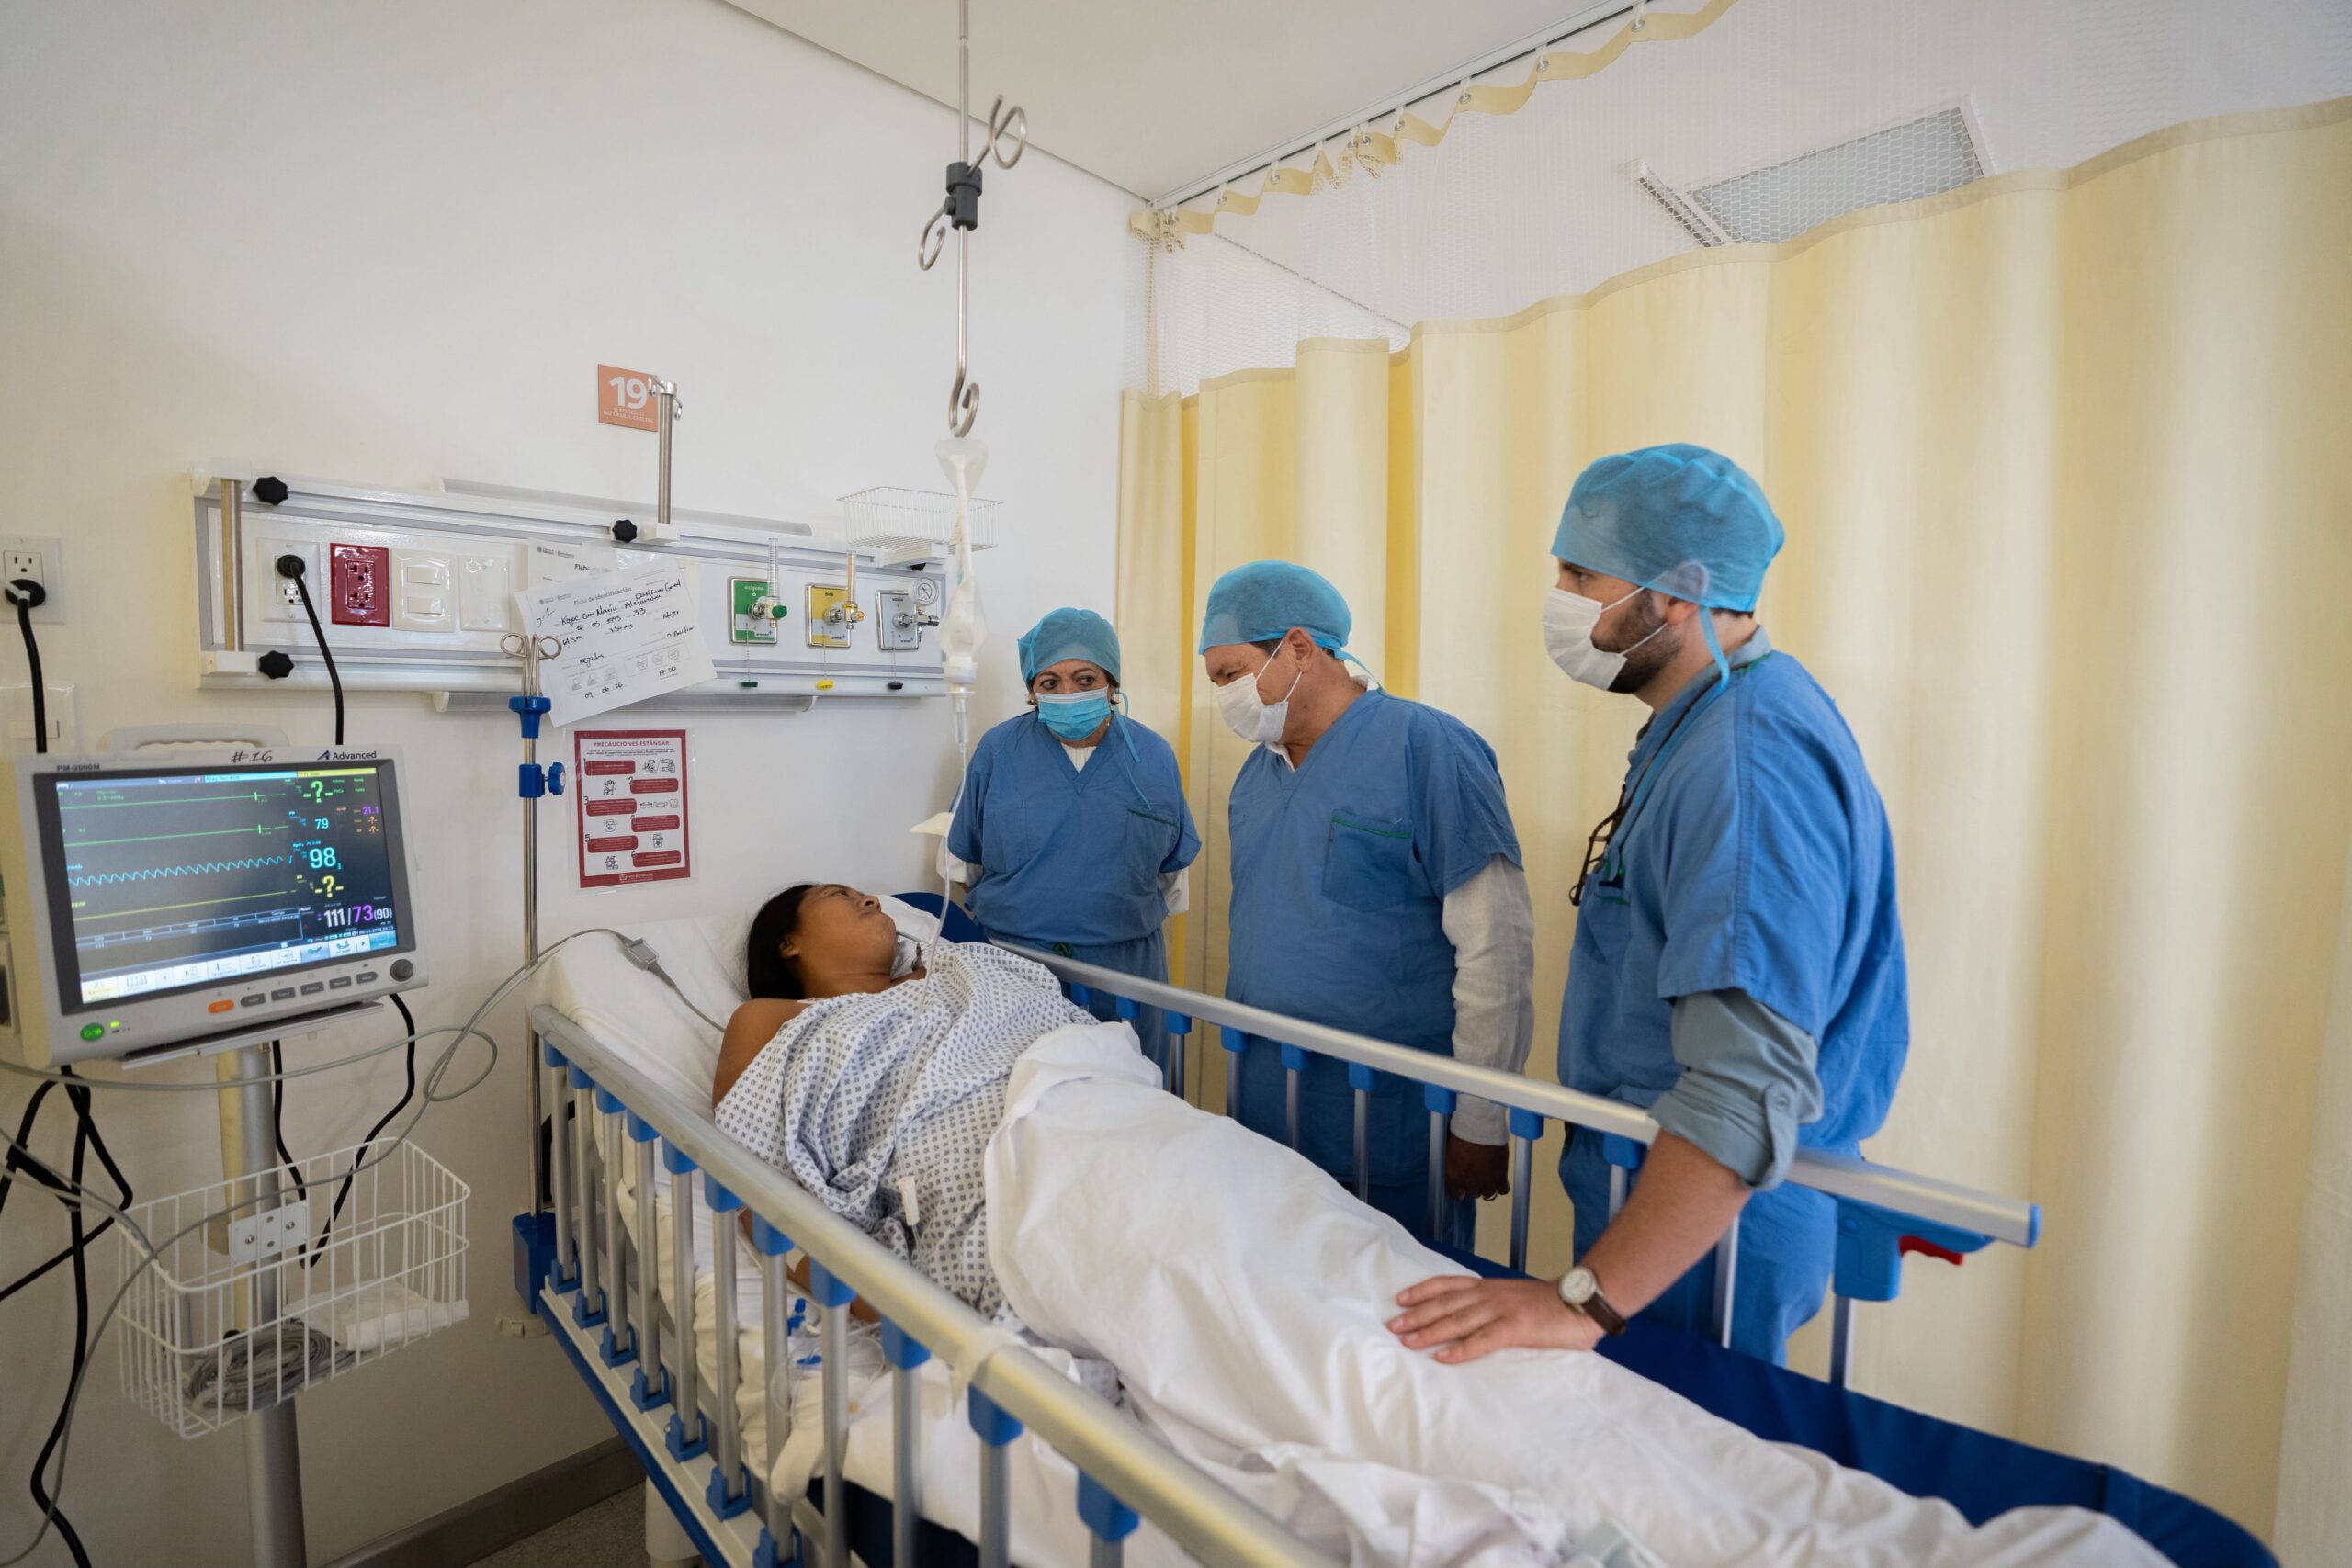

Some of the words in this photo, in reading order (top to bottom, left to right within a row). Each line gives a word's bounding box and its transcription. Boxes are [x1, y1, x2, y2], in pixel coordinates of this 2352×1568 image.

[610, 376, 647, 410] 19
[333, 750, 377, 761] Advanced
[362, 806, 379, 816] 21.1
[314, 818, 329, 830] 79
[309, 847, 336, 869] 98
